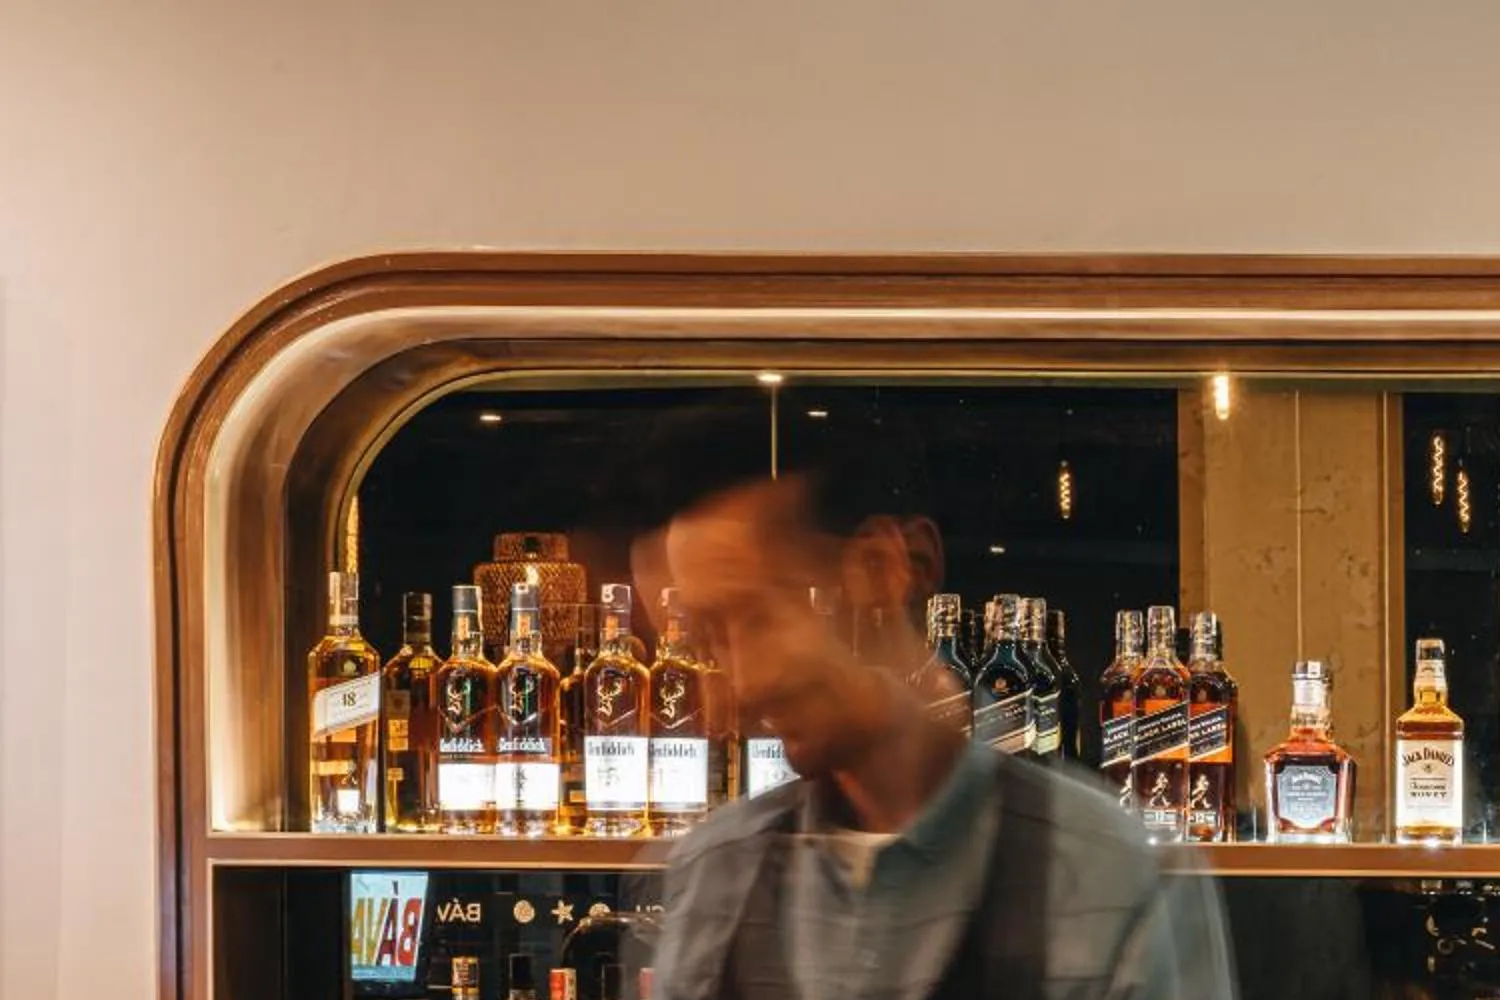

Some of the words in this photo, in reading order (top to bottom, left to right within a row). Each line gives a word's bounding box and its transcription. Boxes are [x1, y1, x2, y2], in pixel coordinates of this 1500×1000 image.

[343, 691, 357, 707] 18
[1402, 750, 1422, 767] JACK
[1410, 791, 1448, 799] HONEY
